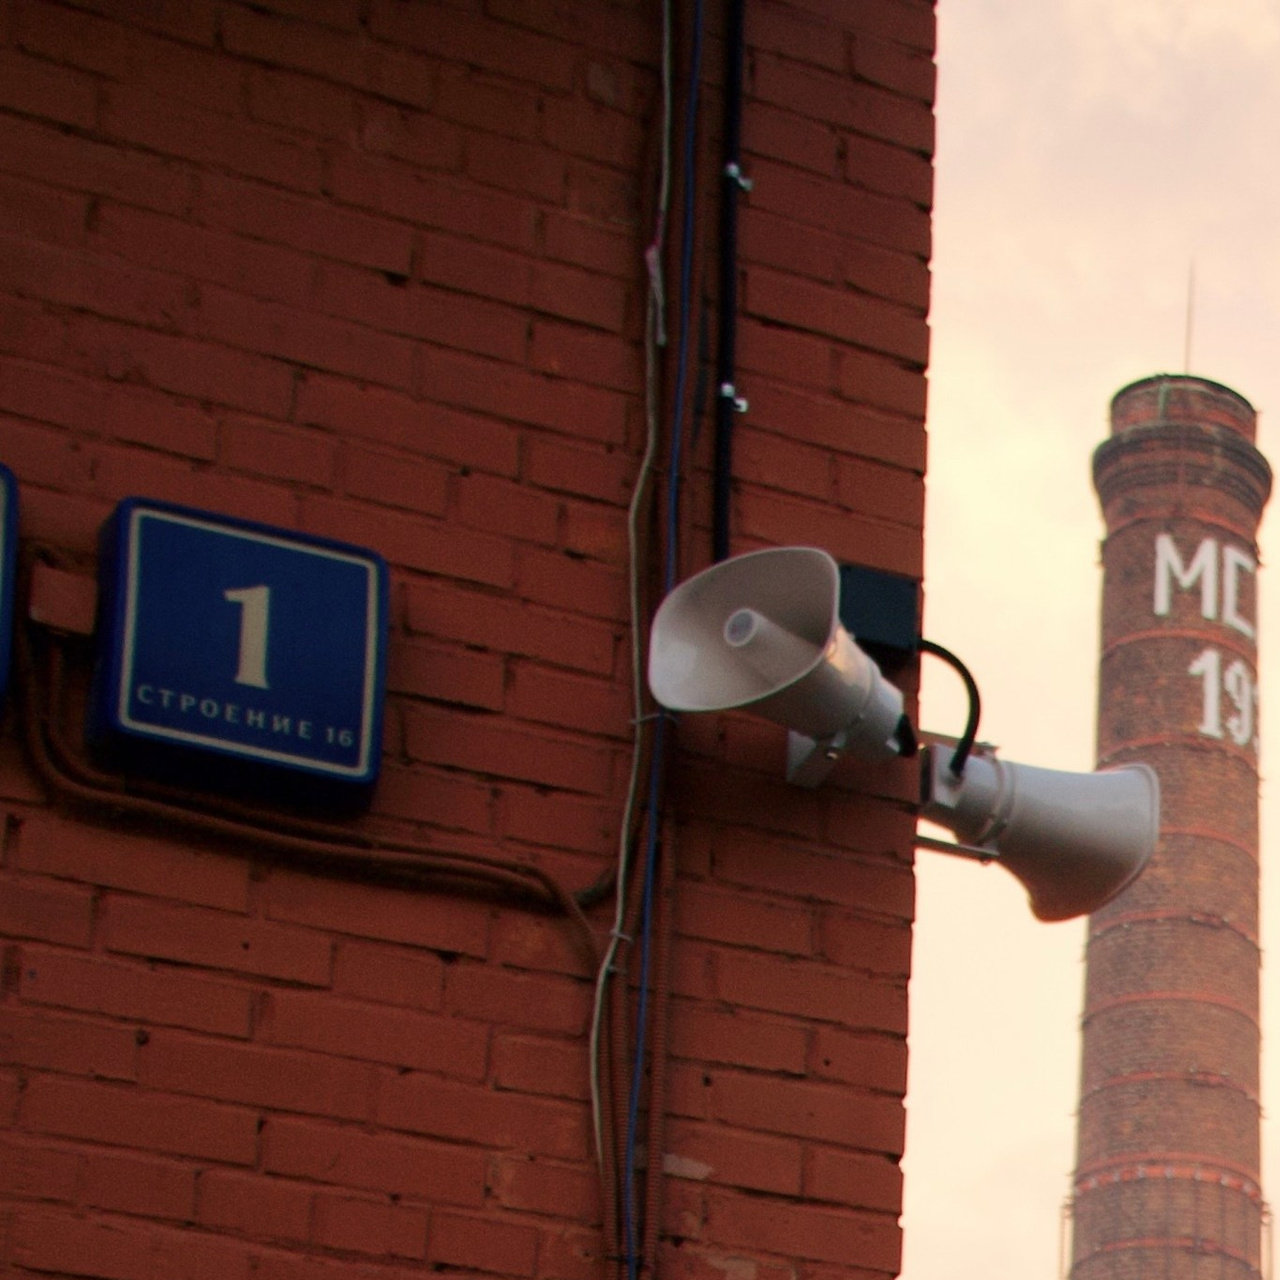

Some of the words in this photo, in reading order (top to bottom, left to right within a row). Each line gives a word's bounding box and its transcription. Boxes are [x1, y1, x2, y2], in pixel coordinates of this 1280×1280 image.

[224, 584, 271, 690] 1
[136, 684, 313, 741] СТРОЕНИЕ
[325, 726, 355, 749] 16
[1188, 648, 1259, 752] 19
